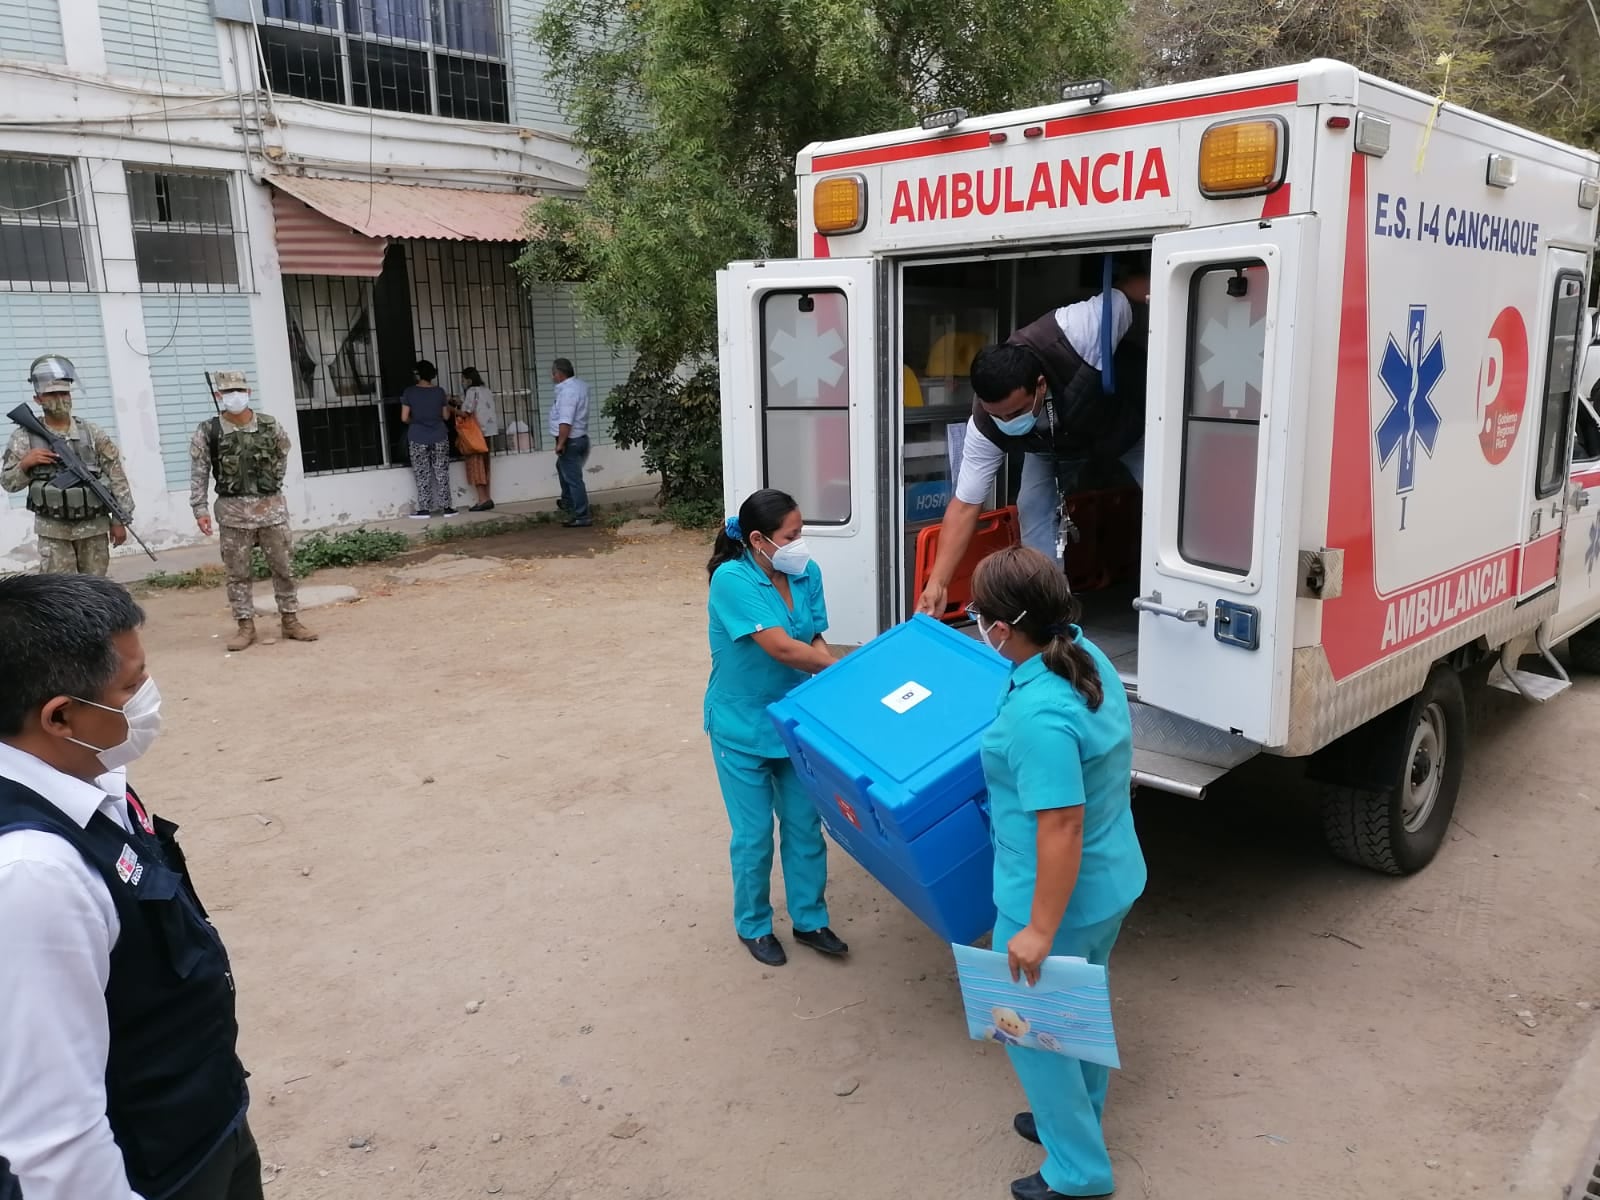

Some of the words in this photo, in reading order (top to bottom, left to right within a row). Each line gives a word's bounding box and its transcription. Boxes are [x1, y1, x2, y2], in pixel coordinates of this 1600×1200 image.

[890, 147, 1171, 224] AMBULANCIA
[1375, 193, 1411, 239] E.S.
[1445, 207, 1539, 256] CANCHAQUE
[1380, 558, 1507, 650] AMBULANCIA
